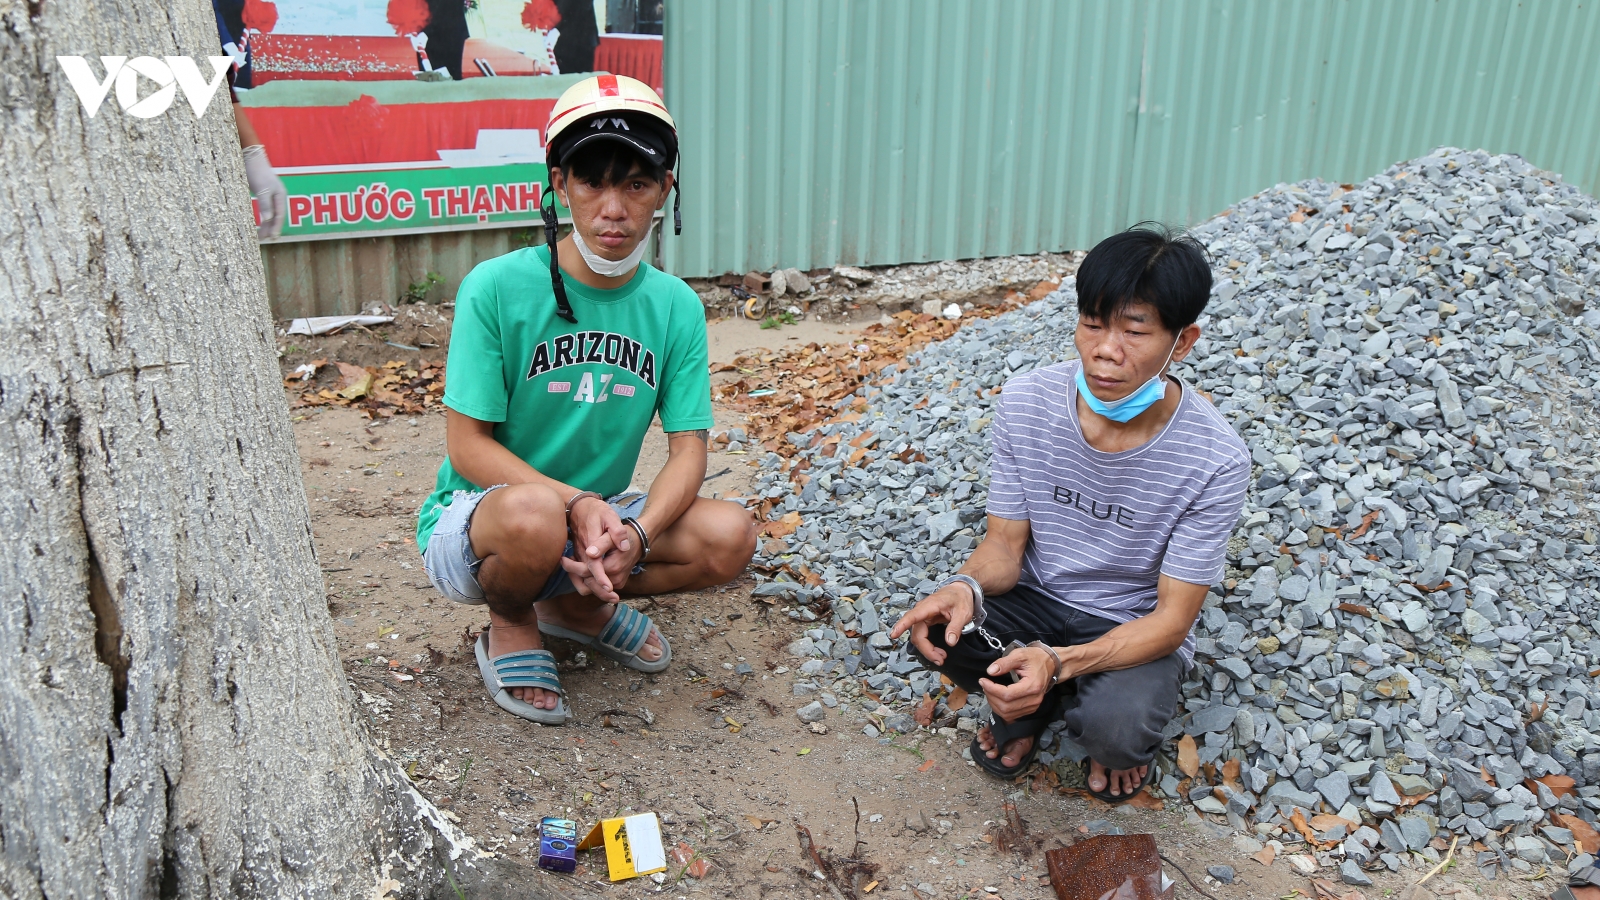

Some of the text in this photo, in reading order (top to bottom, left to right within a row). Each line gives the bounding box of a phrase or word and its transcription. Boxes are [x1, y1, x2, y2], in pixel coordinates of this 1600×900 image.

[289, 183, 414, 227] PHƯỚC
[422, 182, 542, 222] THẠNH
[526, 331, 656, 390] ARIZONA
[551, 372, 632, 403] EST. AZ 1912
[1053, 485, 1135, 529] BLUE
